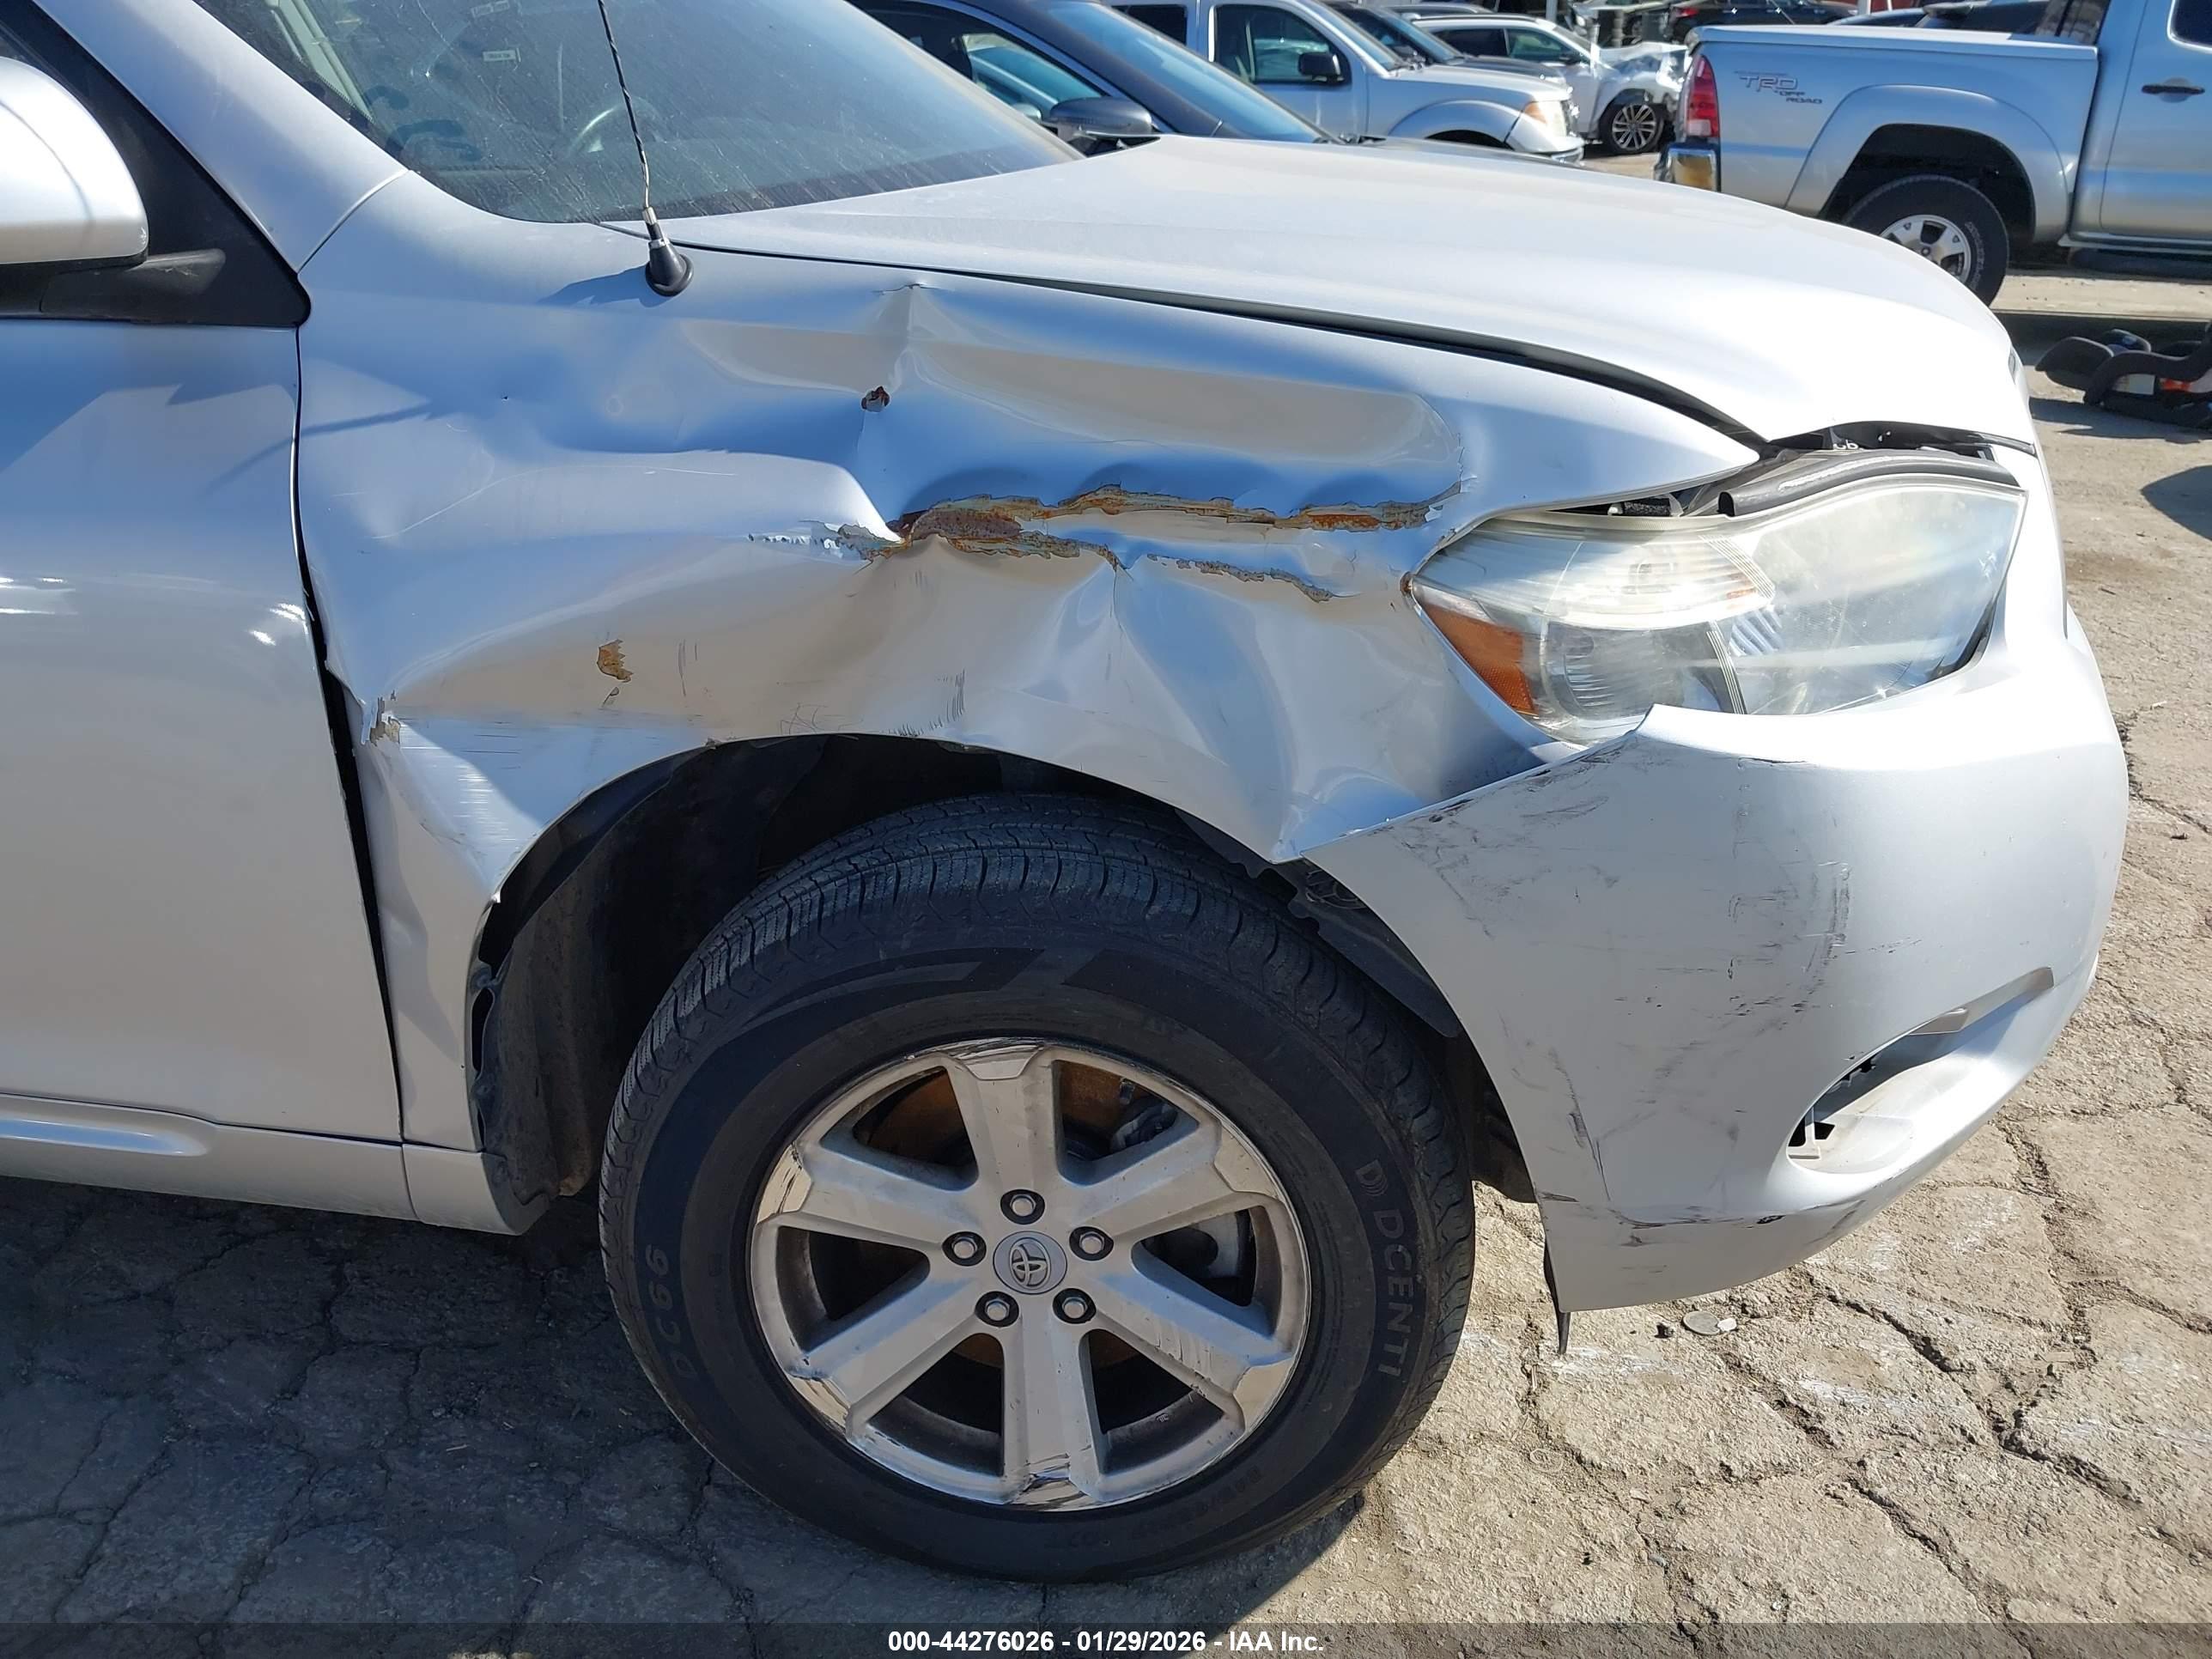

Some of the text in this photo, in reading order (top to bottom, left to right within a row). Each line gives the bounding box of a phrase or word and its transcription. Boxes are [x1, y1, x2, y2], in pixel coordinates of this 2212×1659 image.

[1739, 76, 1800, 93] TRD
[1786, 96, 1823, 105] ROAD
[645, 1243, 700, 1379] DC66
[1373, 1208, 1415, 1378] DCENTI
